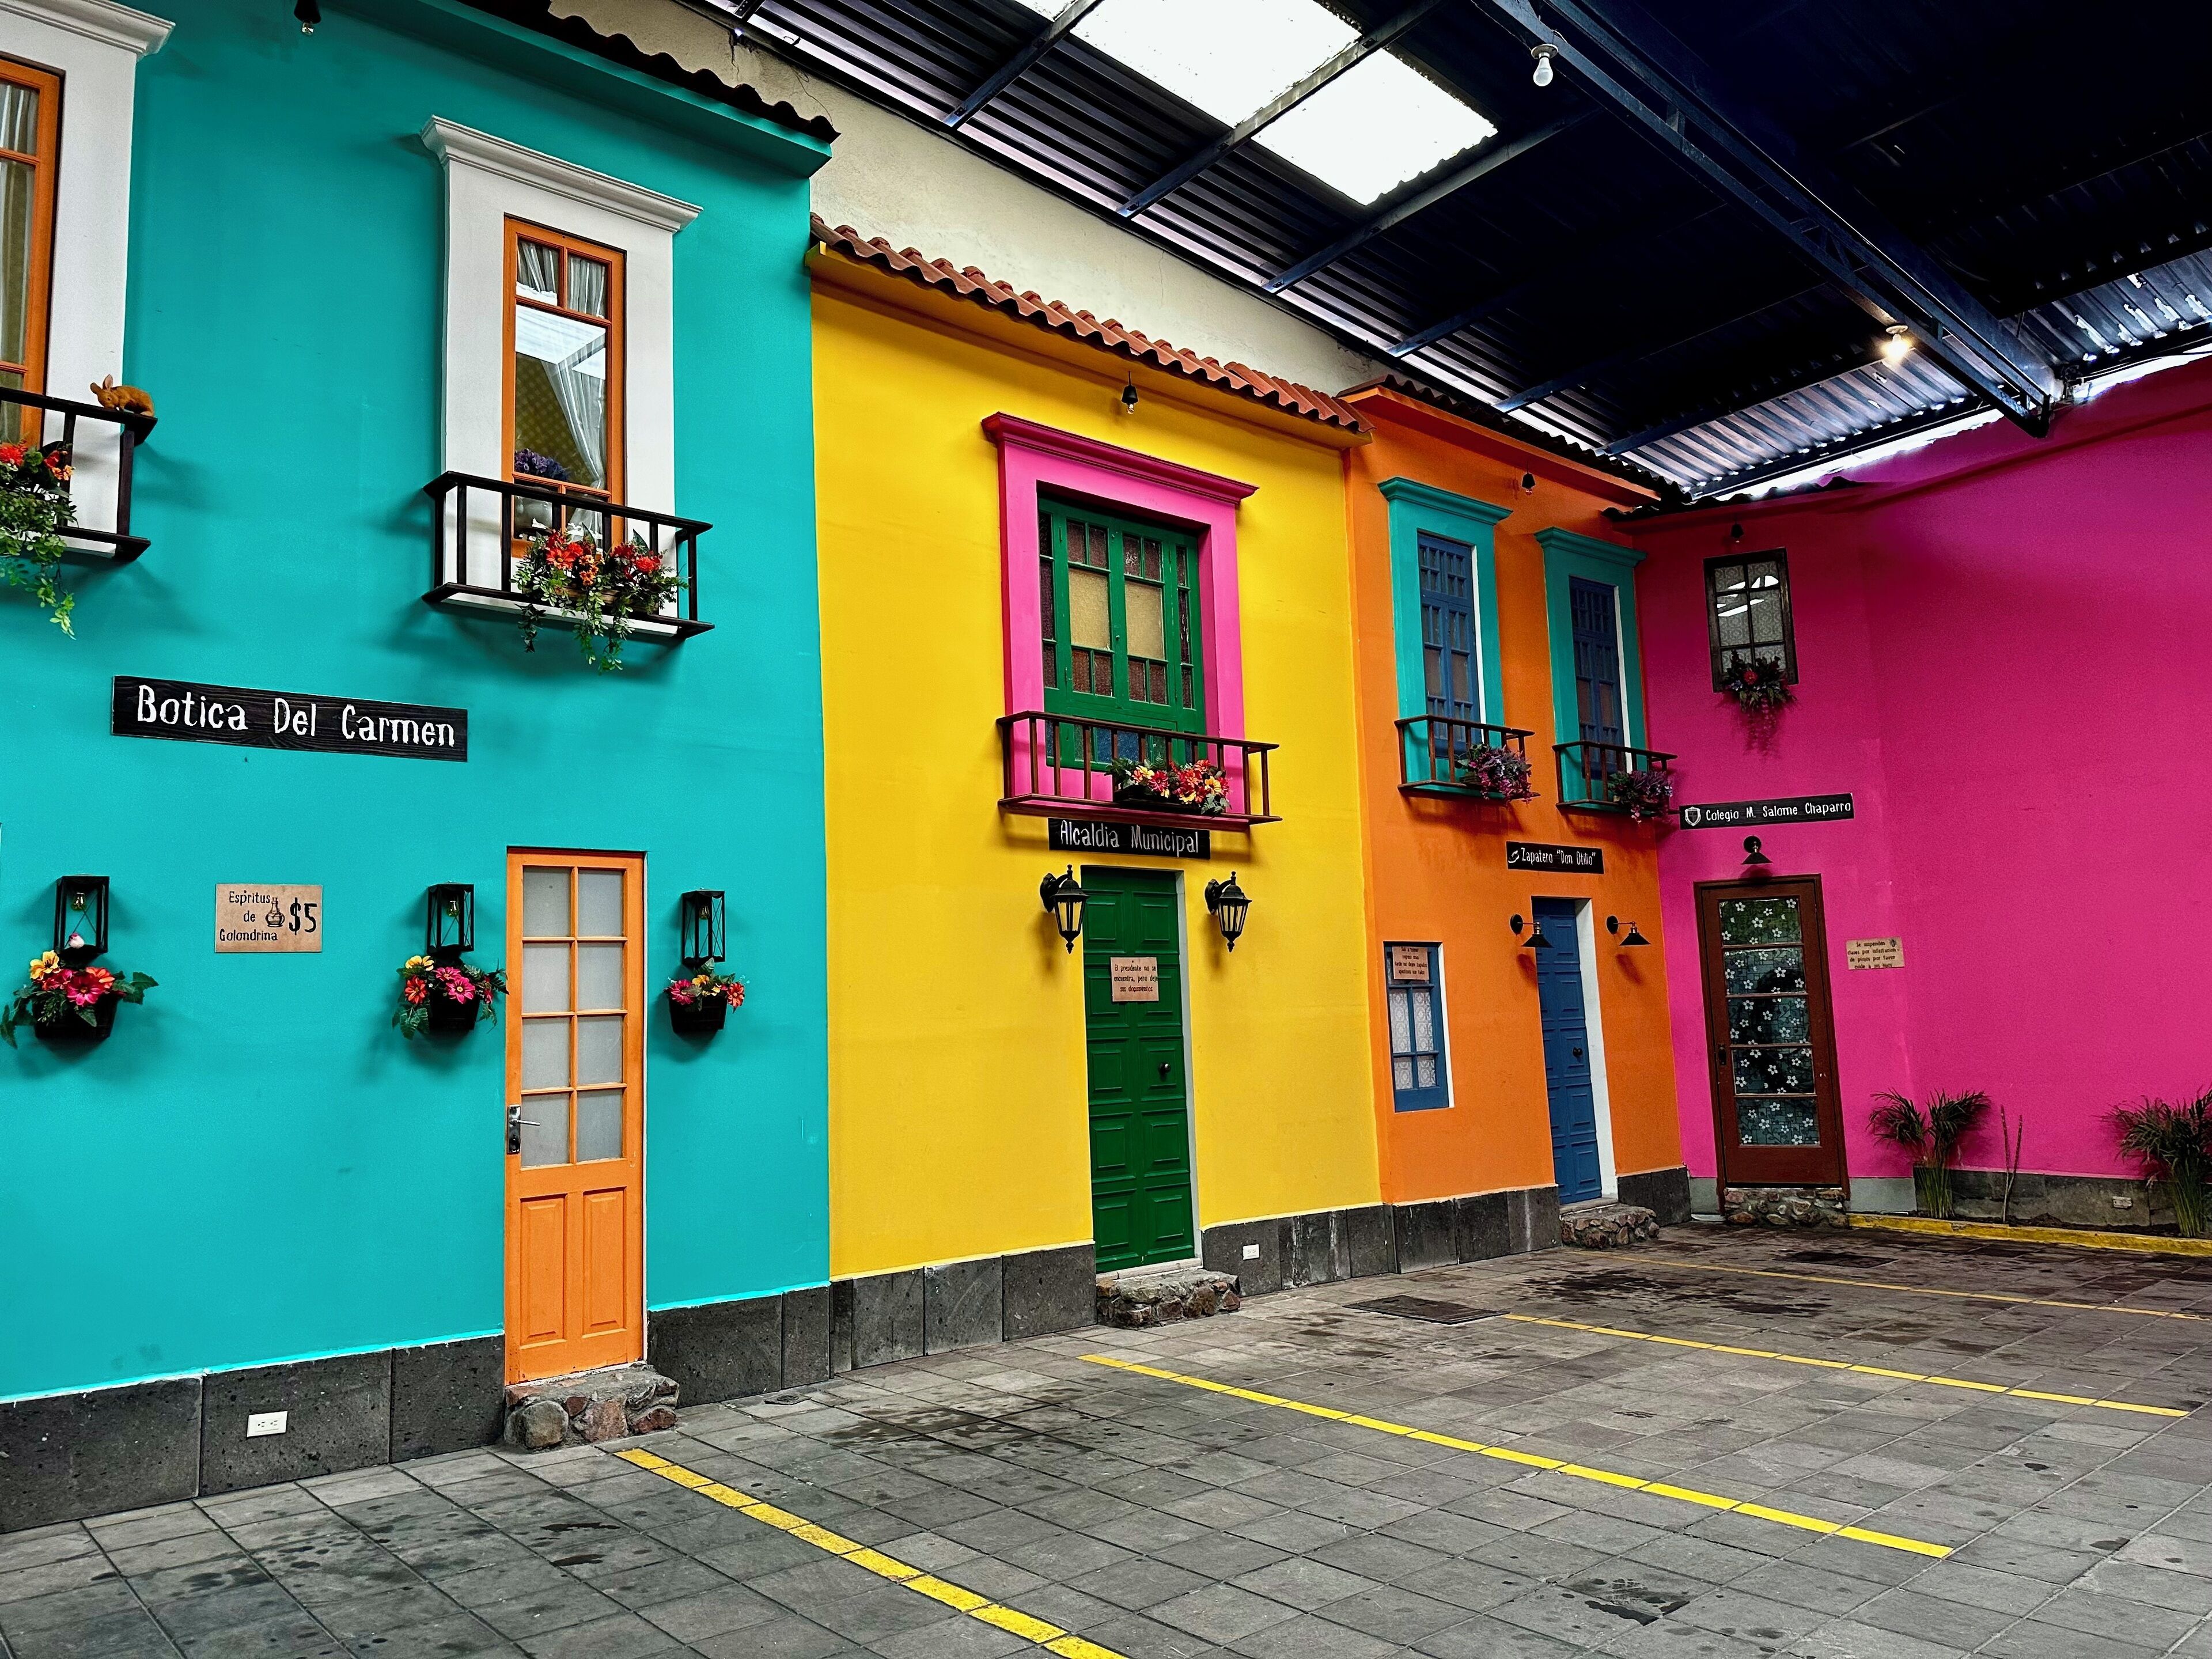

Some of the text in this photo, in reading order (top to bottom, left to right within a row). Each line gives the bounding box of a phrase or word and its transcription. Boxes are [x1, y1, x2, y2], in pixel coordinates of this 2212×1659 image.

[137, 684, 455, 747] Botica Del Carmen
[1706, 802, 1851, 822] Colegio M. Salome Chaparro
[1060, 820, 1199, 858] Alcaldia Municipal
[1521, 847, 1553, 865] Zapatero
[243, 910, 256, 922] de
[289, 897, 317, 935] $5
[219, 928, 278, 941] Golondrina
